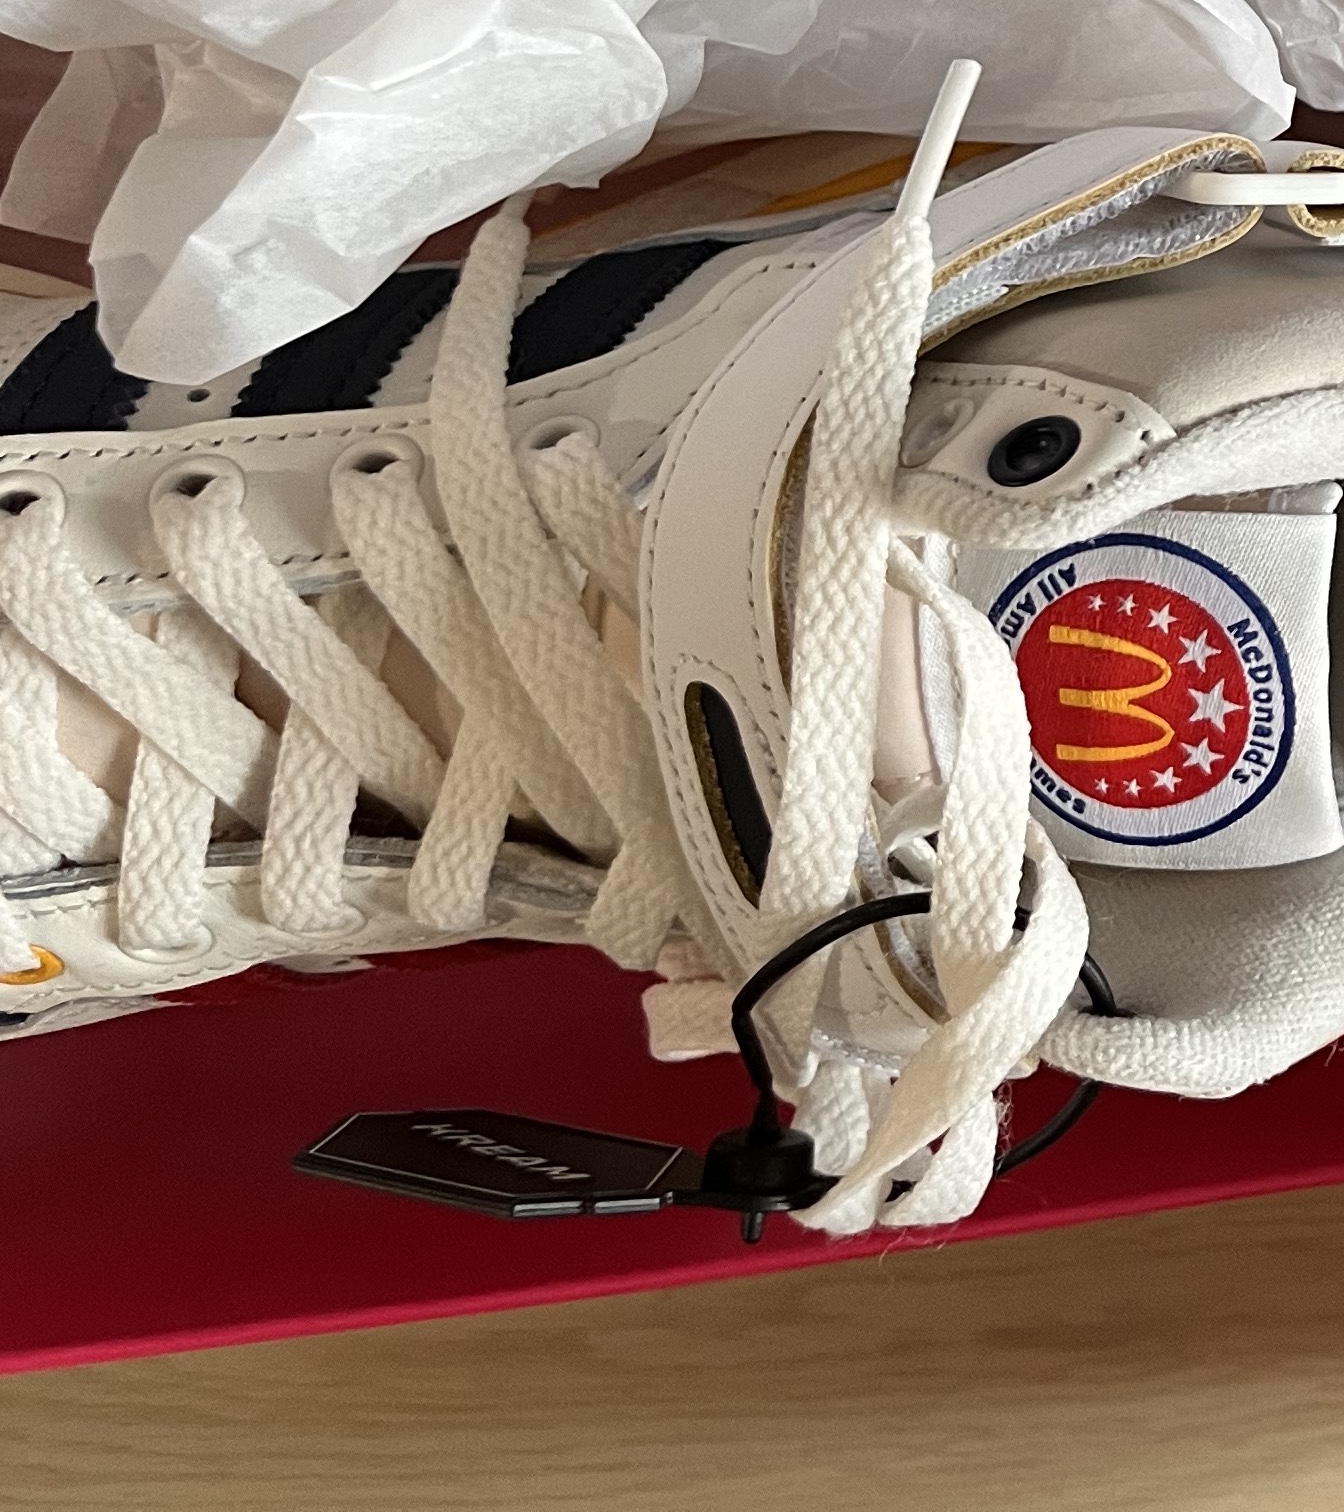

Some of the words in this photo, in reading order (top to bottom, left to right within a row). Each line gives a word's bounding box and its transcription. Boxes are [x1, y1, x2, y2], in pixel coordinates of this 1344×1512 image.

[1037, 562, 1078, 603] All
[1227, 617, 1276, 785] McDonald's
[410, 1123, 592, 1181] KREAM
